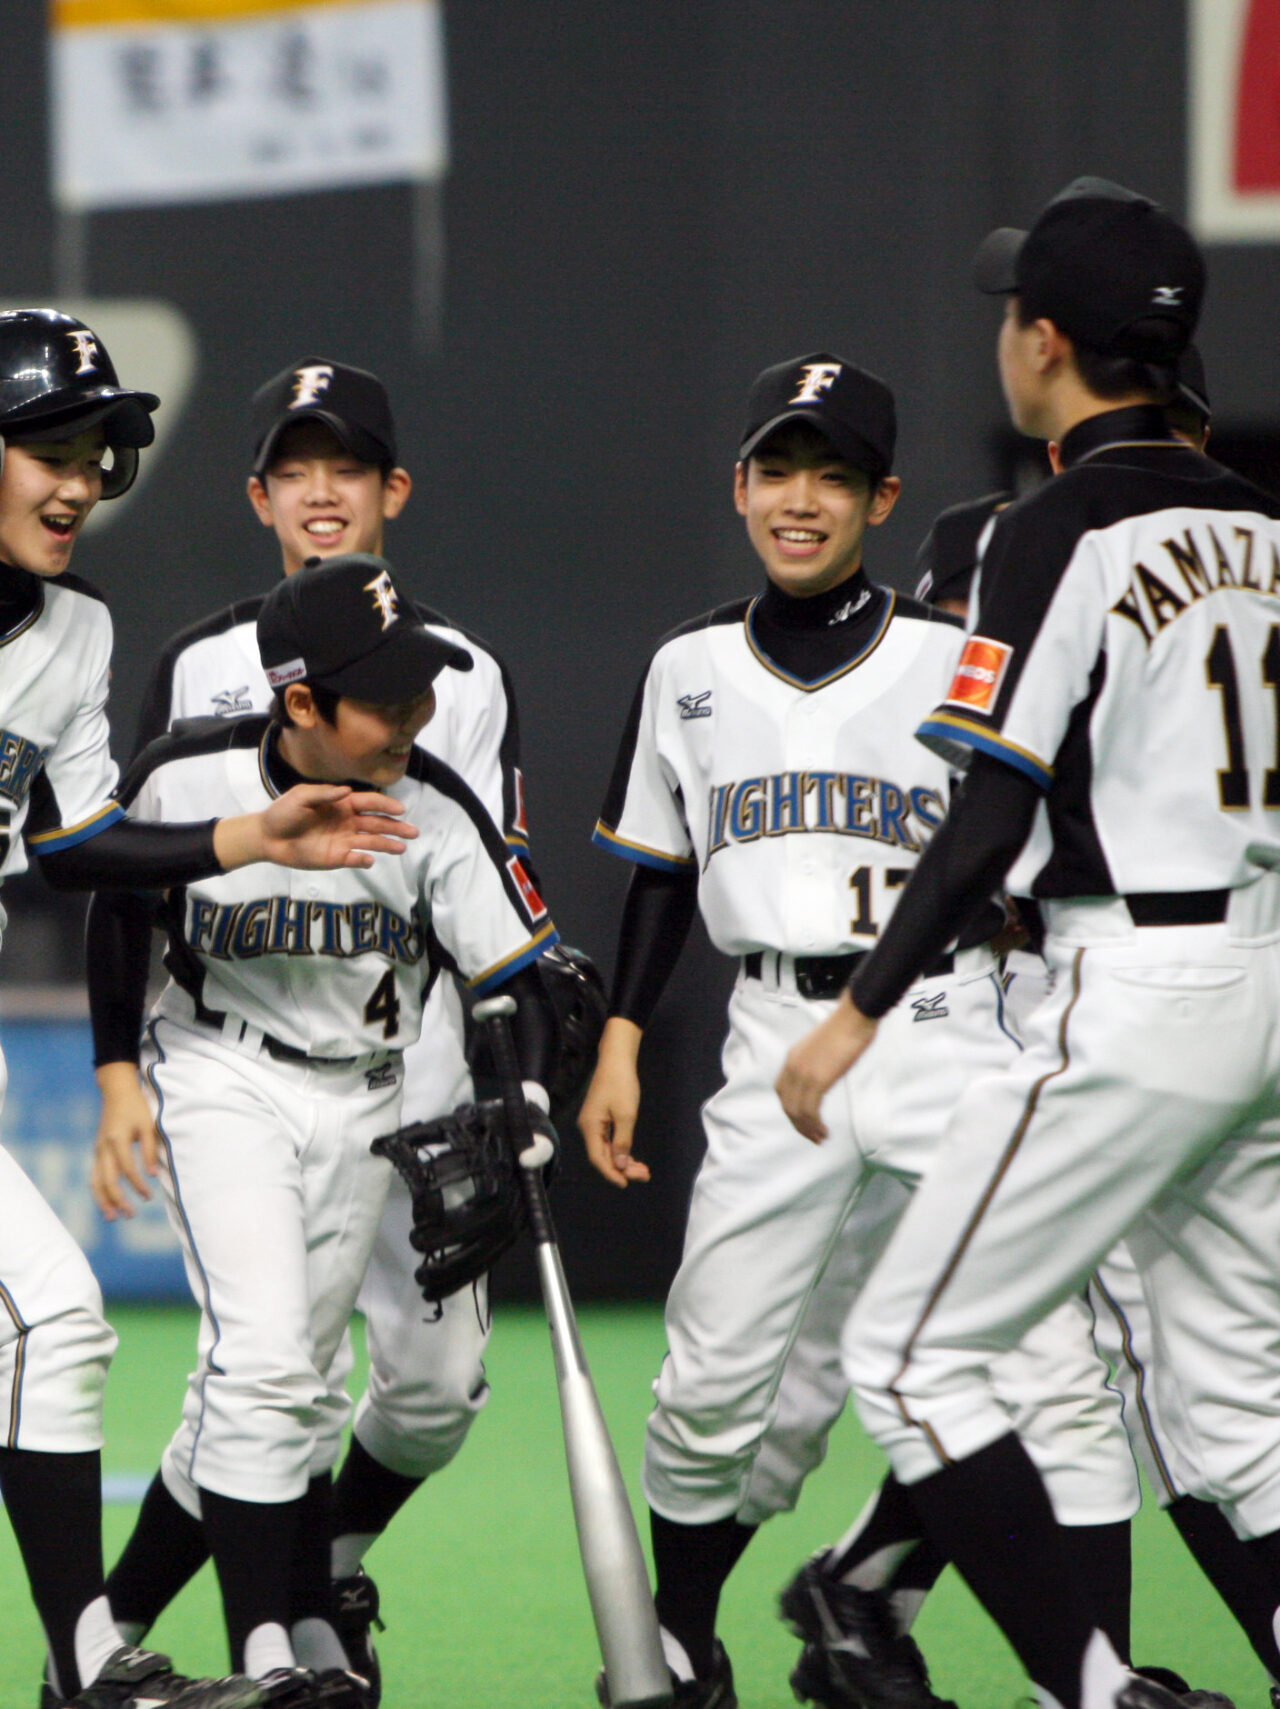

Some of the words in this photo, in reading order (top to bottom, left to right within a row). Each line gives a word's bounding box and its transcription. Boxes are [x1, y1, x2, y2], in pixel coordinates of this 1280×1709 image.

[787, 362, 844, 406] F
[705, 771, 951, 862] IGHTERS
[363, 966, 401, 1041] 4
